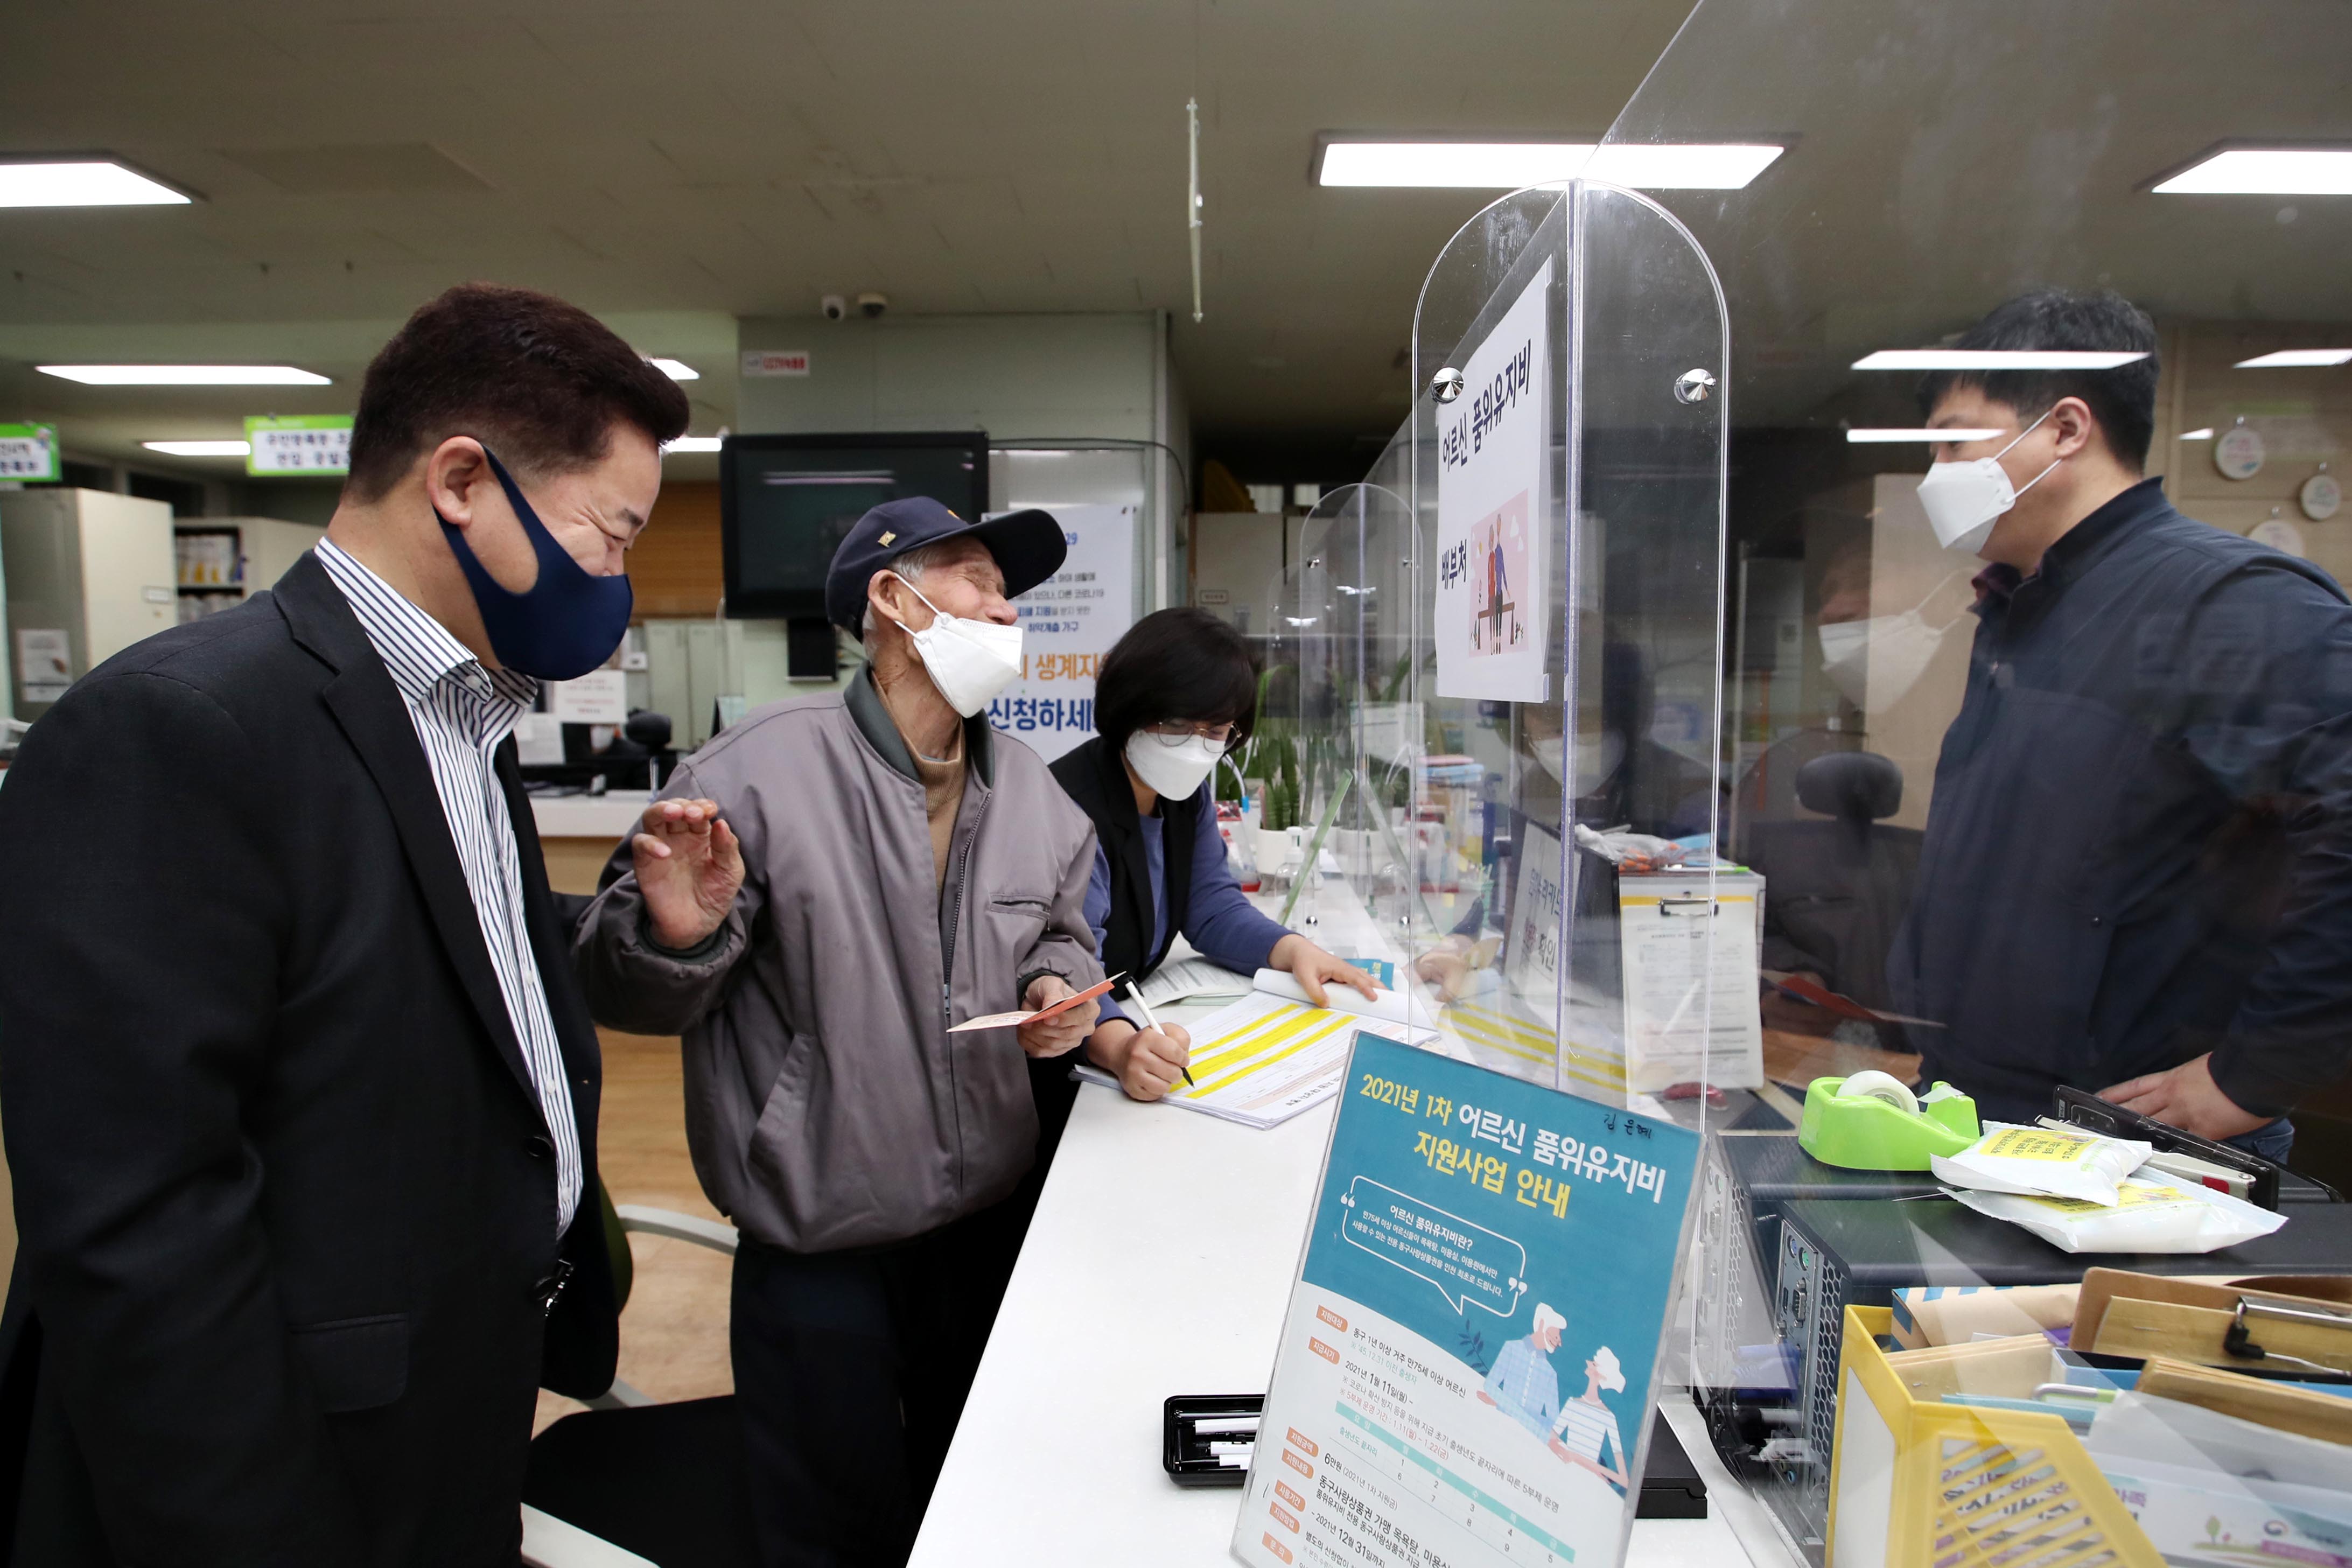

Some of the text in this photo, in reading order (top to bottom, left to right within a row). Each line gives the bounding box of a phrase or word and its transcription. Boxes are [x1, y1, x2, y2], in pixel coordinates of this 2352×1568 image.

[1442, 338, 1532, 473] 어르신 품위유지비
[1441, 538, 1467, 592] 배부처
[1062, 621, 1079, 632] 가구
[1035, 653, 1105, 681] 생계지
[988, 698, 1097, 732] 신청하세
[1360, 1074, 1667, 1205] 2021년 1차 어르신 품위유지비
[1604, 1113, 1616, 1131] 김
[1413, 1131, 1571, 1219] 지원사업 안내
[1363, 1210, 1499, 1279] 만75세 이상 어르신들이 목욕탕, 미용실, 이용원에서만
[1390, 1205, 1474, 1251] 어르신 품위유지비란?
[1352, 1220, 1503, 1298] 사용할 수 있는 전용 동구사랑상품권을 인천 최초로 드립니다.
[1321, 1310, 1343, 1328] 지원대상
[1313, 1341, 1335, 1361] 지급시기
[1353, 1328, 1467, 1399] 동구 1년 이상 거주 만75세 이상 어르신
[1385, 1360, 1398, 1375] 이전
[1398, 1366, 1417, 1385] 출생자
[1345, 1360, 1367, 1380] 2021년
[1369, 1373, 1381, 1388] 1월
[1382, 1380, 1408, 1404] 11일(월)
[1291, 1432, 1314, 1453] 지원금액
[1347, 1391, 1362, 1406] 5부제
[1363, 1401, 1375, 1415] 운영
[1376, 1409, 1388, 1423] 기간
[1424, 1439, 1449, 1460] 1.22(금)
[1349, 1379, 1560, 1514] 코로나 확산 방지 등을 위해 지급 초기 출생년도 끝자리에 따른 5부제 운영
[1279, 1485, 1301, 1507] 사용기간
[1324, 1453, 1398, 1511] 6만원 (2021년 1차 지원금)
[1339, 1427, 1361, 1445] 출생년도
[1401, 1459, 1404, 1467] 1
[1434, 1481, 1439, 1489] 2
[1469, 1503, 1475, 1513] 3
[1508, 1529, 1513, 1537] 4
[1548, 1554, 1553, 1564] 5
[1316, 1488, 1346, 1517] 품위유지비
[1346, 1511, 1359, 1527] 전용
[1360, 1521, 1405, 1560] 동구사랑상품권
[1319, 1475, 1373, 1521] 동구사랑상품권
[1374, 1514, 1392, 1535] 가맹
[1393, 1527, 1420, 1557] 목욕탕,
[1397, 1473, 1402, 1481] 6
[1467, 1518, 1472, 1528] 8
[1505, 1544, 1510, 1552] 9
[1306, 1531, 1324, 1551] 별도의
[1315, 1513, 1337, 1535] 2021년
[1339, 1529, 1355, 1549] 12월
[1355, 1541, 1386, 1568] 31일까지
